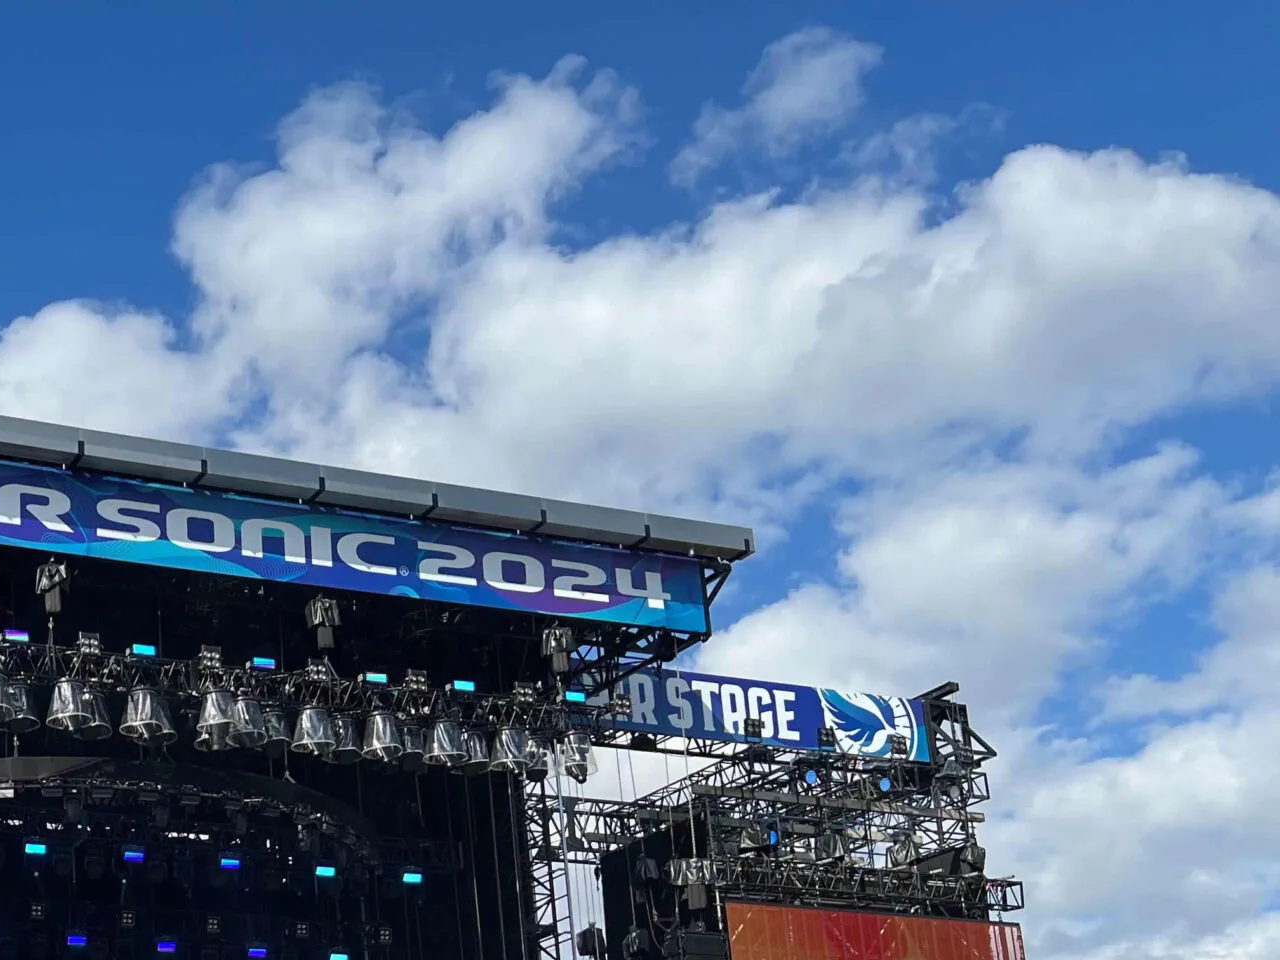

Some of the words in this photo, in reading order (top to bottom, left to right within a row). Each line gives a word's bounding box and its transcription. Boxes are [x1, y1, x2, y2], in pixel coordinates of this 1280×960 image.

[96, 499, 398, 575] SONIC
[418, 543, 672, 609] 2024
[666, 677, 801, 741] STAGE
